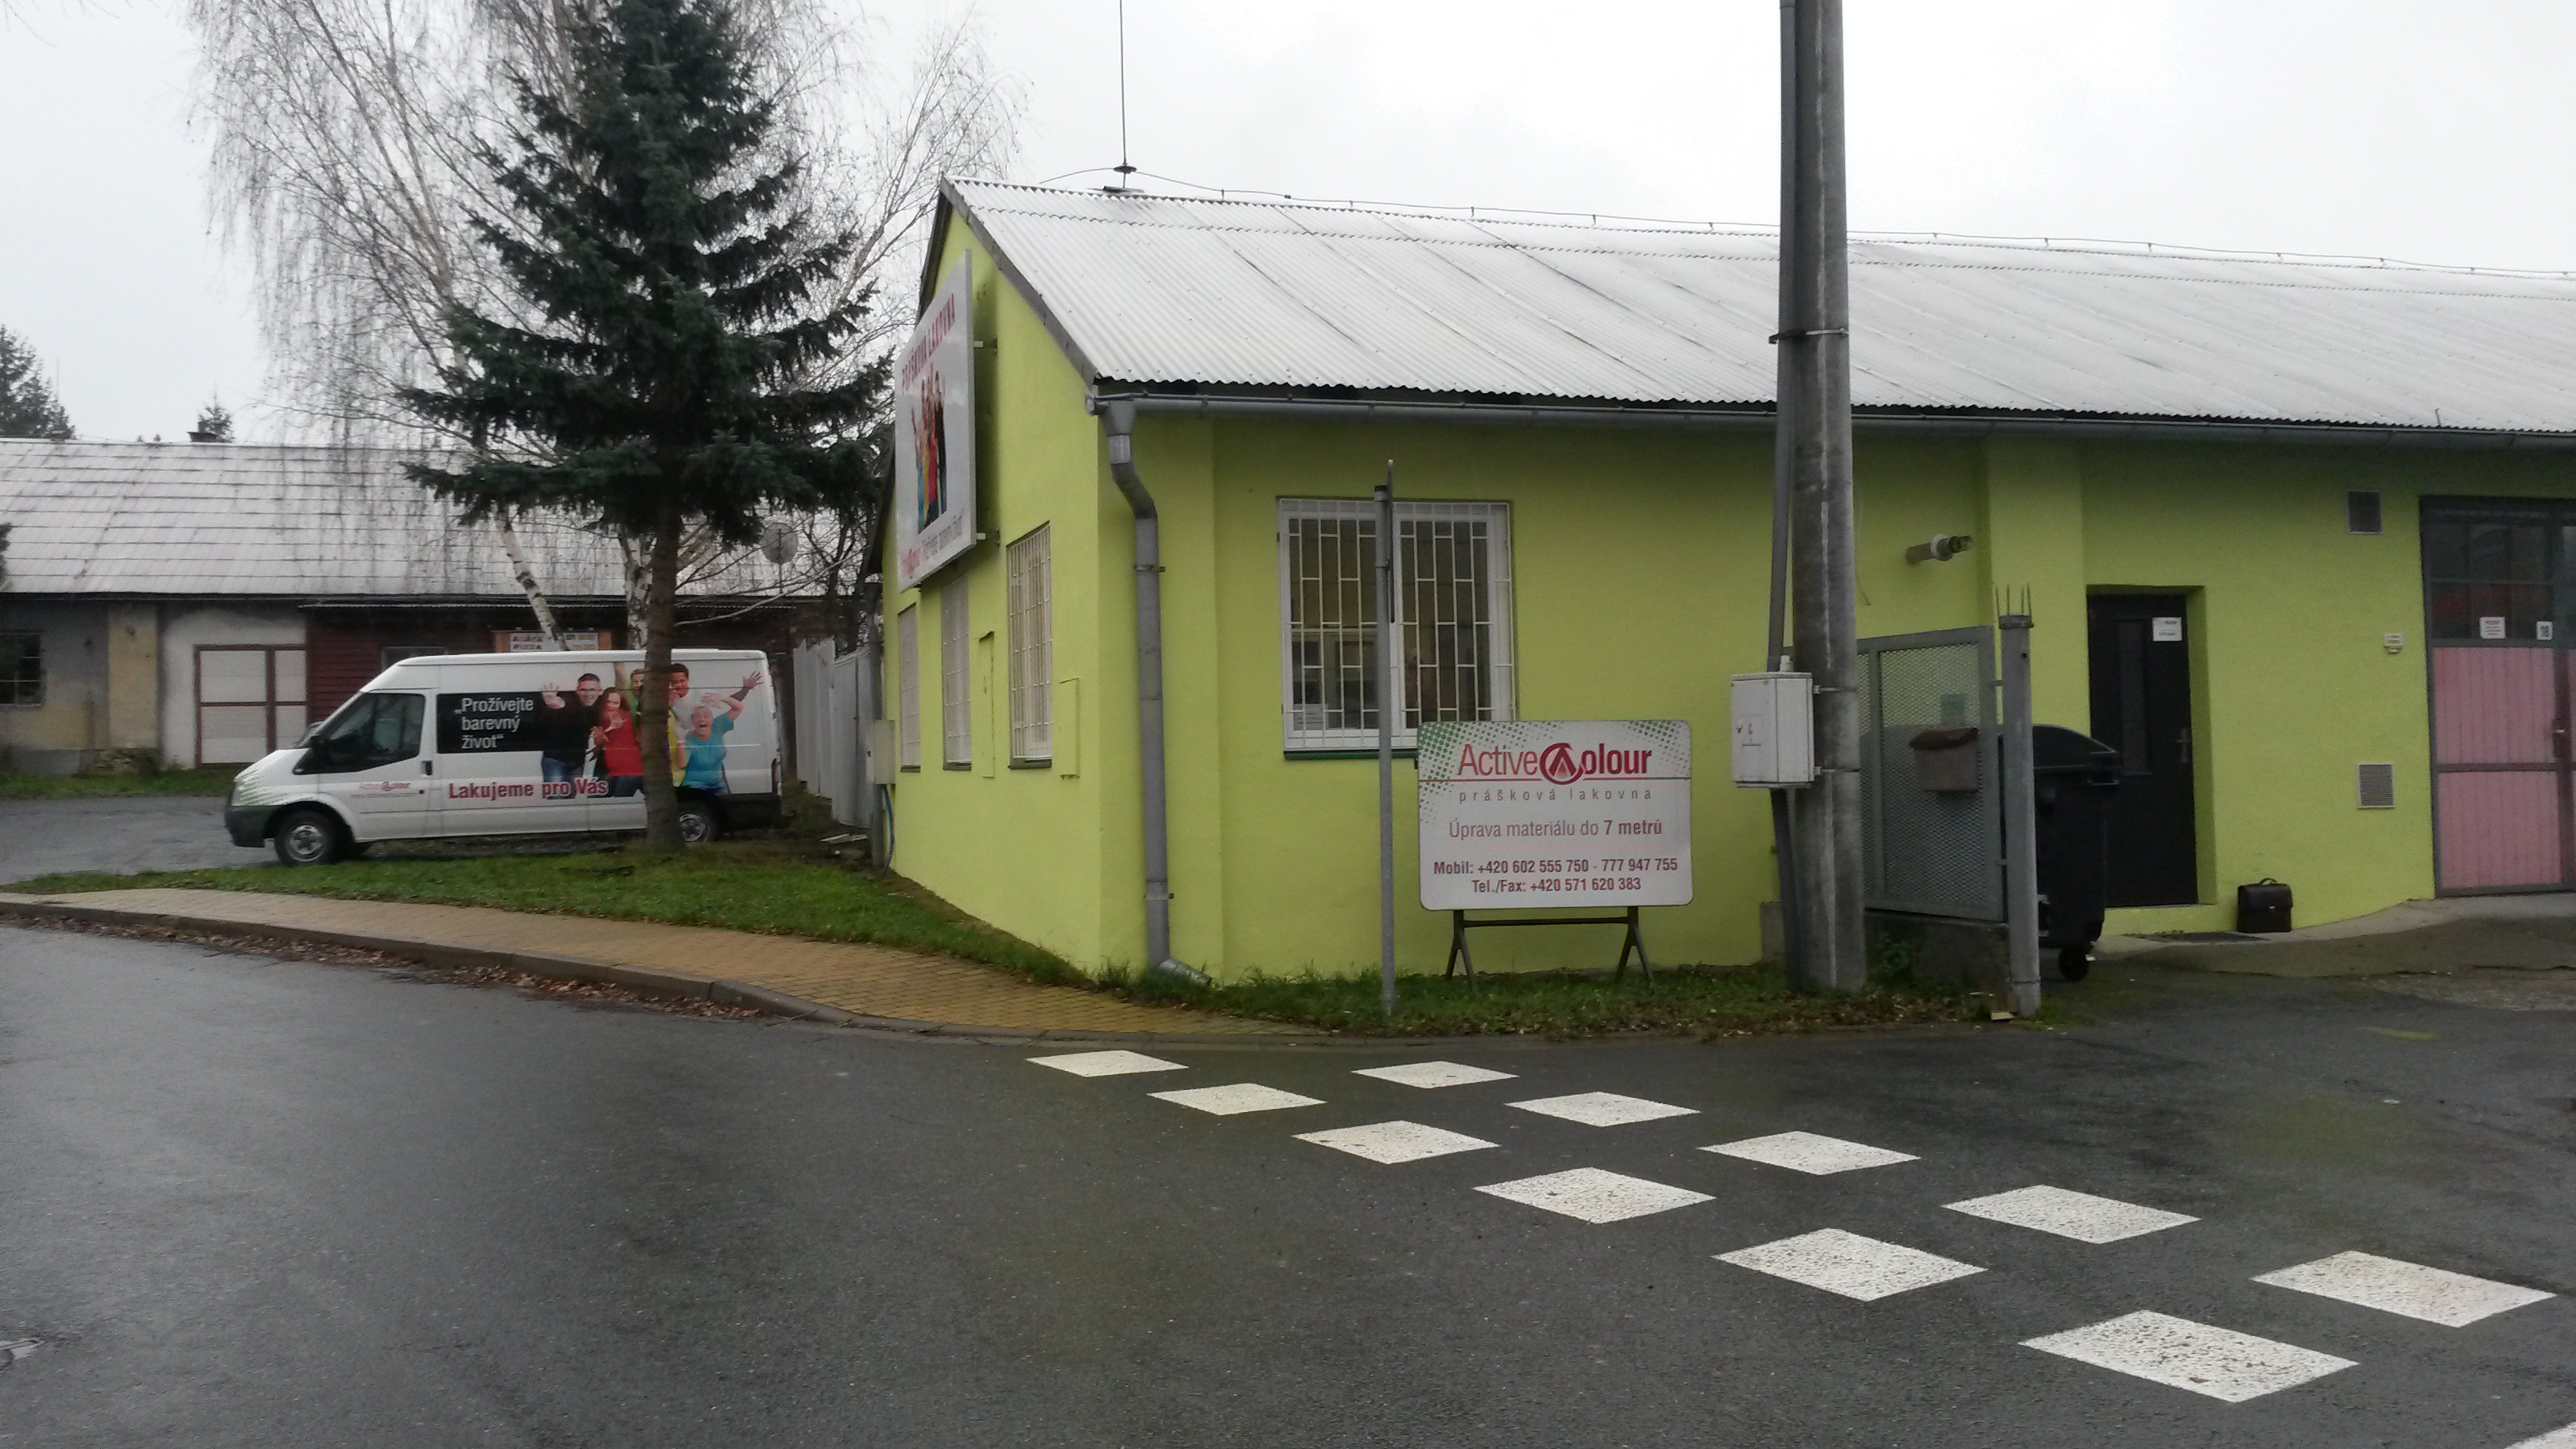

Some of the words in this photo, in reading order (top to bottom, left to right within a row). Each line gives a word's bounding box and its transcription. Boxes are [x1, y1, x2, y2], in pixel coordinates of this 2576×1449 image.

[461, 715, 521, 733] barevný
[448, 782, 534, 801] Lakujeme
[542, 782, 571, 799] pro
[575, 777, 608, 796] Vás
[1459, 788, 1556, 803] prášková
[1569, 788, 1652, 800] lakovna
[1449, 818, 1501, 841] Úprava
[1507, 820, 1574, 837] materiálu
[1580, 820, 1599, 836] do
[1603, 819, 1613, 835] 7
[1433, 860, 1473, 874] Mobil:
[1477, 860, 1508, 874] +420
[1512, 859, 1535, 873] 602
[1539, 859, 1562, 873] 555
[1566, 859, 1589, 872] 750
[1601, 858, 1624, 871] 777
[1628, 858, 1651, 871] 947
[1654, 857, 1678, 871] 755
[1471, 879, 1526, 893] Tel./Fax:
[1530, 878, 1561, 892] +420
[1564, 878, 1586, 891] 571
[1591, 877, 1615, 891] 620
[1618, 877, 1642, 890] 383
